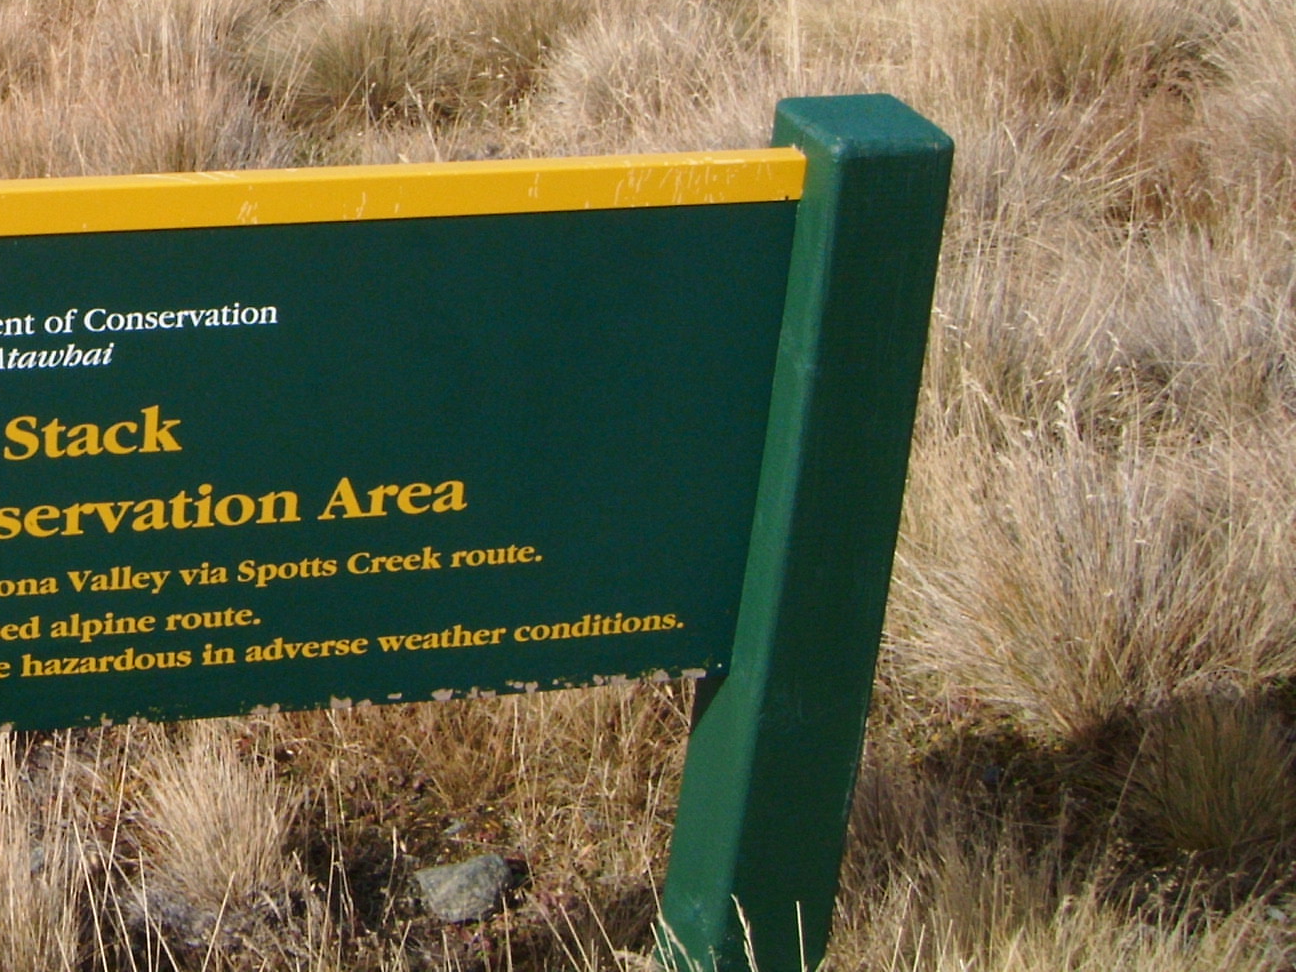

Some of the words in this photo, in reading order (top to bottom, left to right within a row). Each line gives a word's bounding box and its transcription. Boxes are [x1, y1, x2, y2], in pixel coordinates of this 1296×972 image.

[45, 309, 78, 333] of
[84, 303, 277, 331] Conservation
[4, 405, 182, 460] Stack
[318, 477, 467, 520] Area
[68, 566, 170, 594] Valley
[180, 562, 228, 585] via
[238, 558, 337, 587] Spotts
[347, 547, 441, 574] Creek
[451, 545, 542, 567] route.
[21, 648, 192, 676] hazardous
[203, 644, 235, 665] in
[245, 638, 368, 662] adverse
[378, 625, 506, 652] weather
[514, 613, 683, 641] conditions.
[51, 613, 155, 642] alpine
[166, 608, 260, 630] route.
